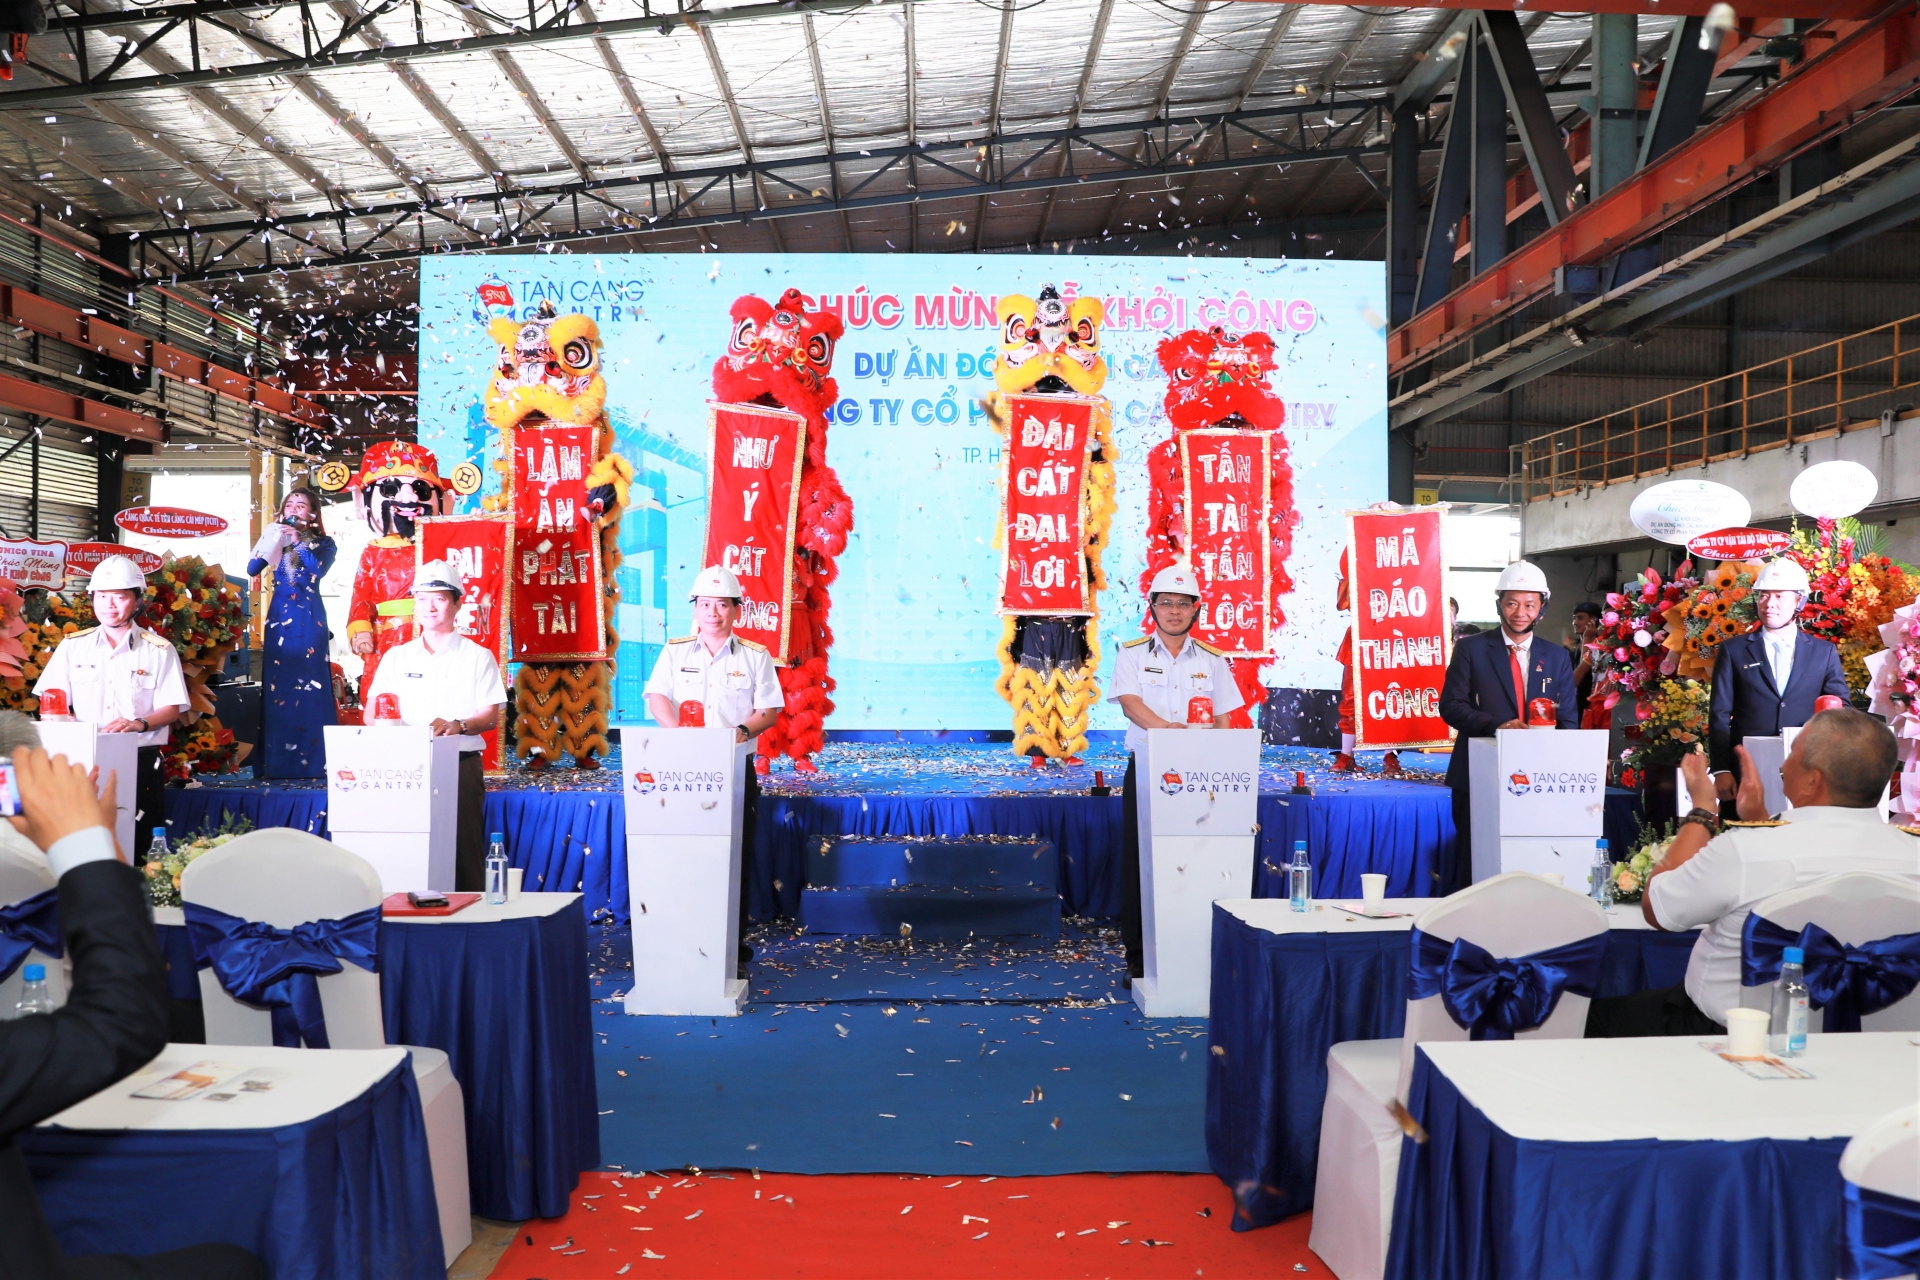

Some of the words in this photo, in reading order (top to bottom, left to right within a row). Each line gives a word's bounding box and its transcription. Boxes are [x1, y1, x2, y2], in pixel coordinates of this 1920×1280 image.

[521, 280, 564, 302] TAN
[571, 280, 644, 302] CANG
[914, 285, 999, 326] MỪN
[1200, 290, 1316, 331] CÔNG
[854, 349, 895, 384] DỰ
[903, 346, 945, 376] ÁN
[956, 346, 997, 377] ĐÓ
[869, 399, 901, 423] TY
[911, 385, 959, 424] CỔ
[733, 435, 779, 469] NHƯ
[963, 447, 983, 464] TP.
[1021, 418, 1075, 456] ĐẠI
[526, 437, 581, 482] LÀM
[1016, 459, 1076, 498] CÁT
[1198, 441, 1251, 484] TẤN
[743, 481, 760, 522] Ý
[1015, 513, 1068, 549] ĐẠI
[1376, 527, 1420, 568] MÃ
[522, 541, 591, 586] PHÁT
[722, 536, 767, 577] CÁT
[532, 594, 578, 635] TÀI
[1369, 577, 1427, 620] ĐÁO
[1359, 628, 1443, 669] THÀNH
[1368, 681, 1440, 720] CÔNG
[359, 769, 382, 780] TAN
[385, 769, 423, 780] CANG
[361, 781, 423, 790] GANTRY
[658, 771, 682, 782] TAN
[684, 771, 724, 783] CANG
[659, 783, 724, 792] GANTRY
[1185, 771, 1209, 783] TAN
[1211, 771, 1251, 783] CANG
[1186, 784, 1250, 793] GANTRY
[1532, 772, 1556, 783] TAN
[1558, 772, 1598, 784] CANG
[1533, 785, 1597, 794] GANTRY
